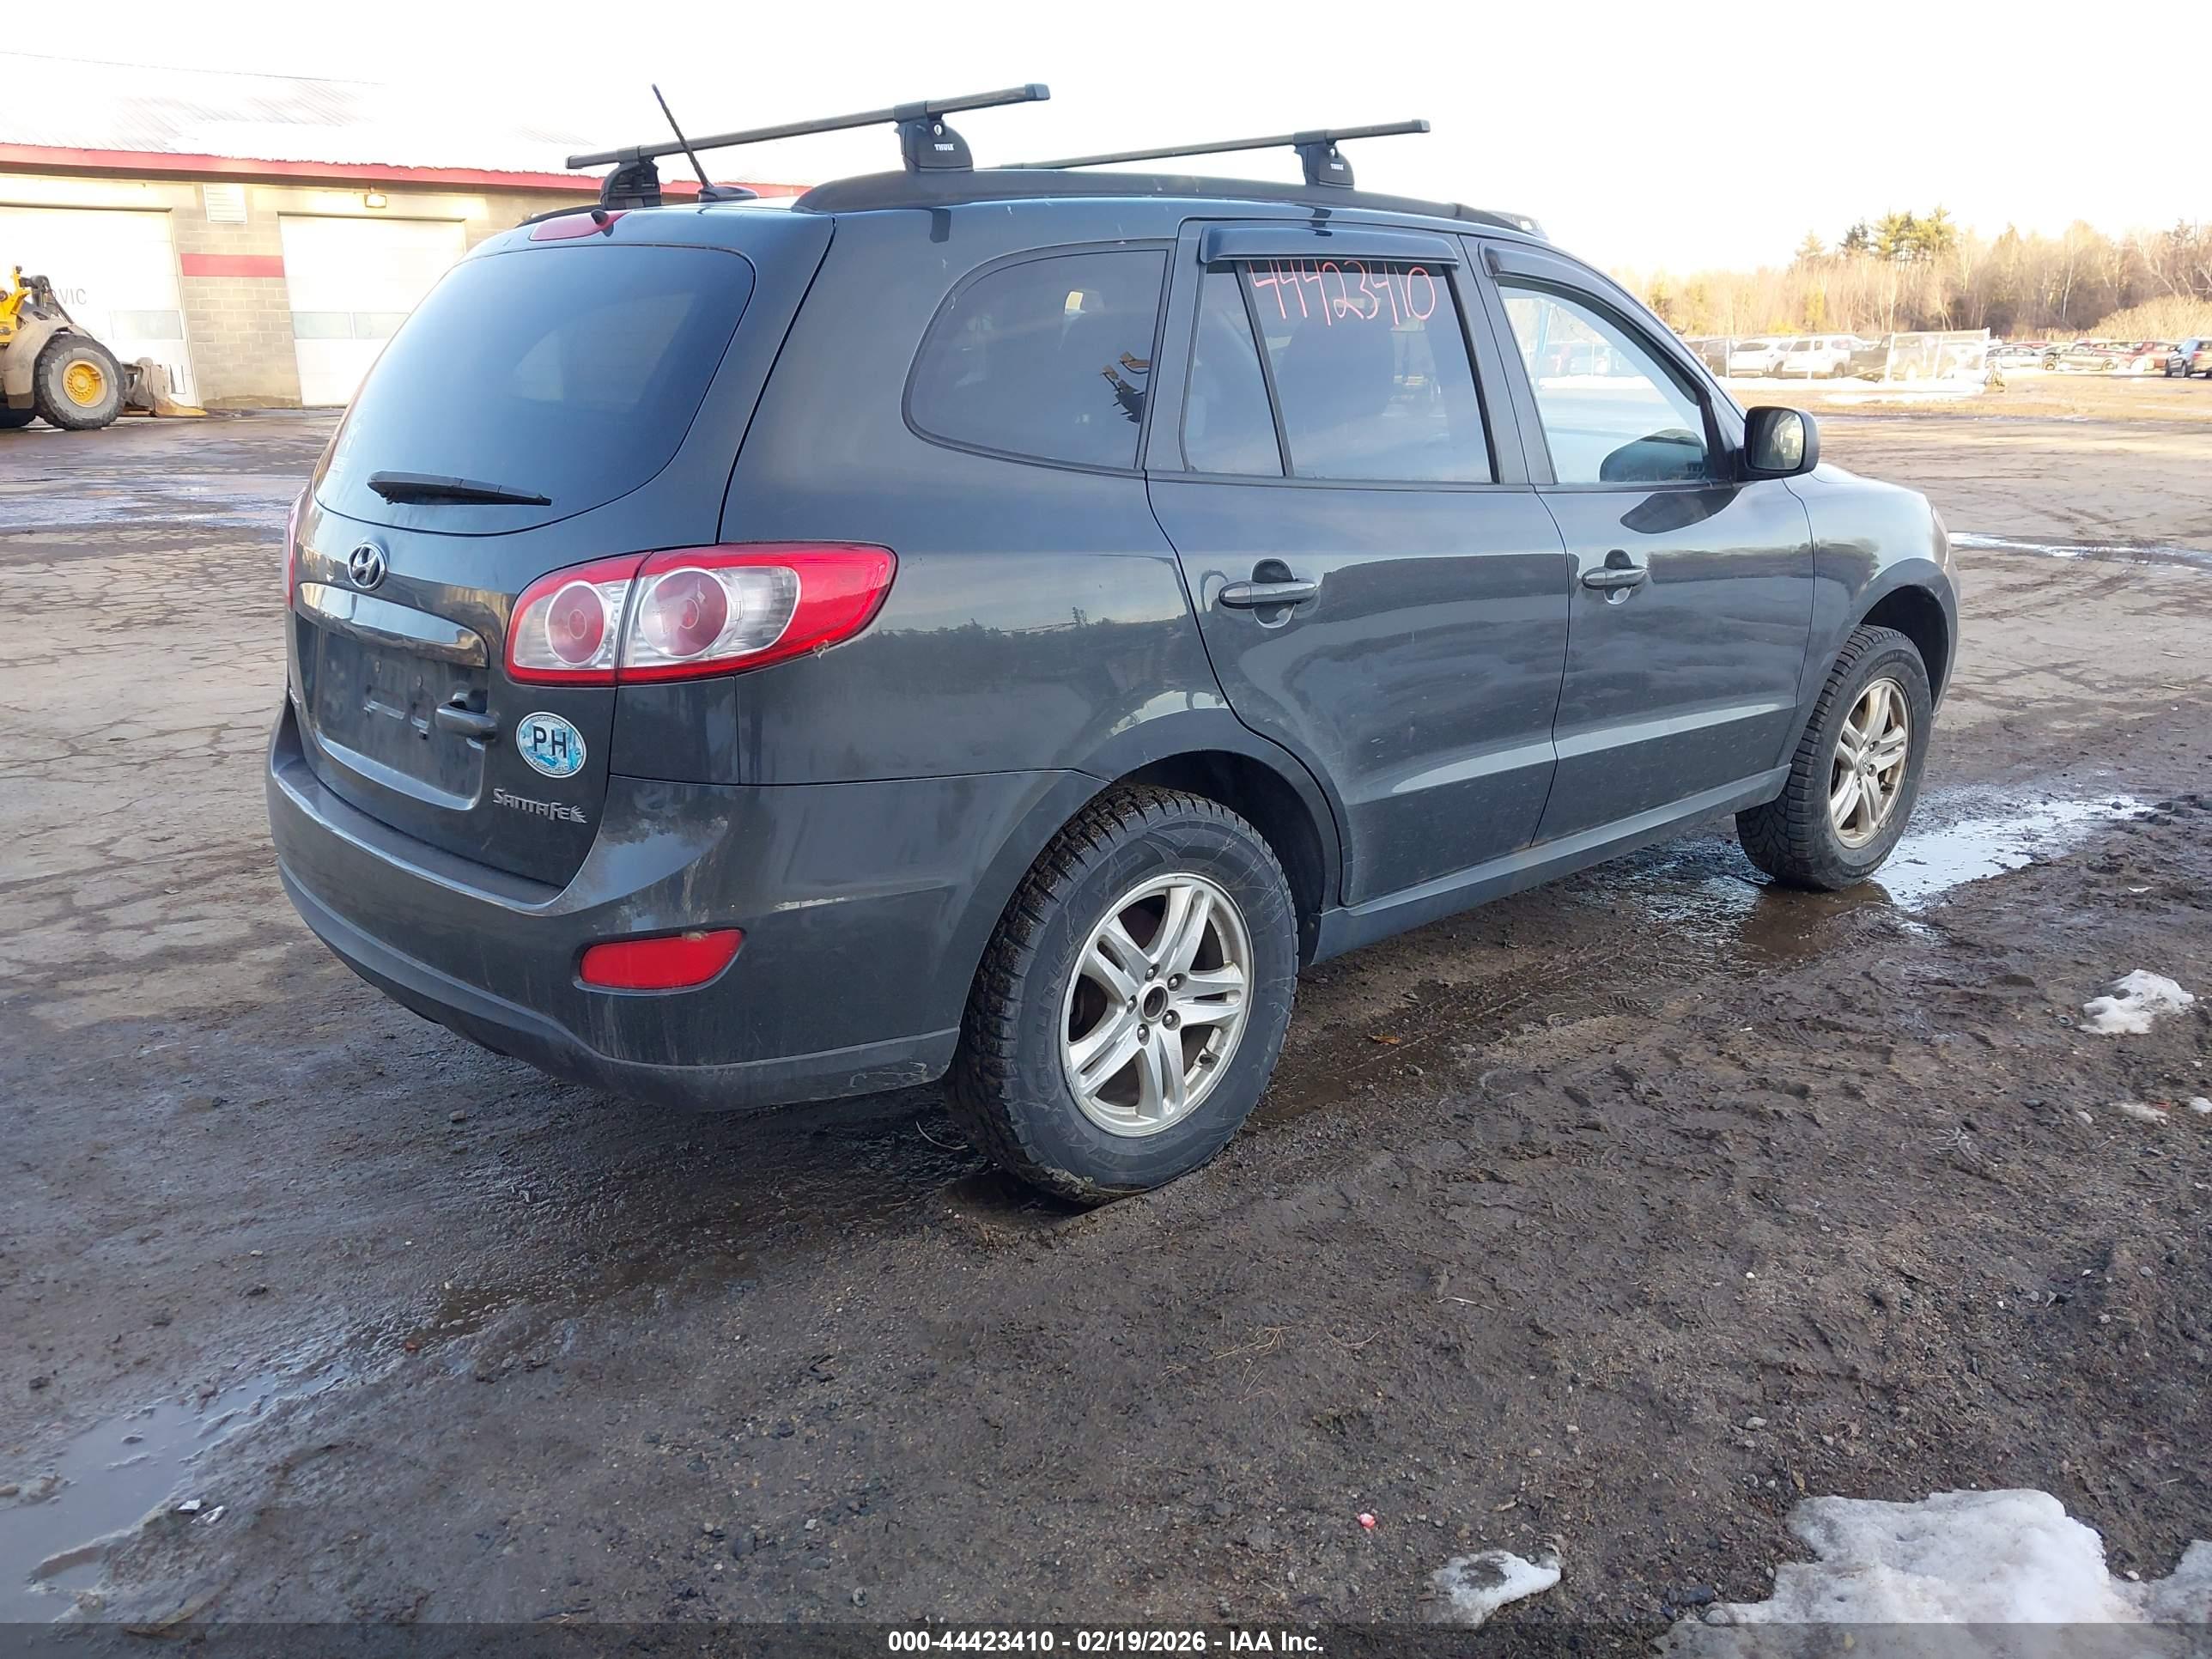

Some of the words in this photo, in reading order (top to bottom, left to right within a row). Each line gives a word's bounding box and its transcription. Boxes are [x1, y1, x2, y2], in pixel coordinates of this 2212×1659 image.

[933, 143, 955, 151] THULE
[1248, 257, 1437, 326] 44423410
[532, 726, 567, 758] PH
